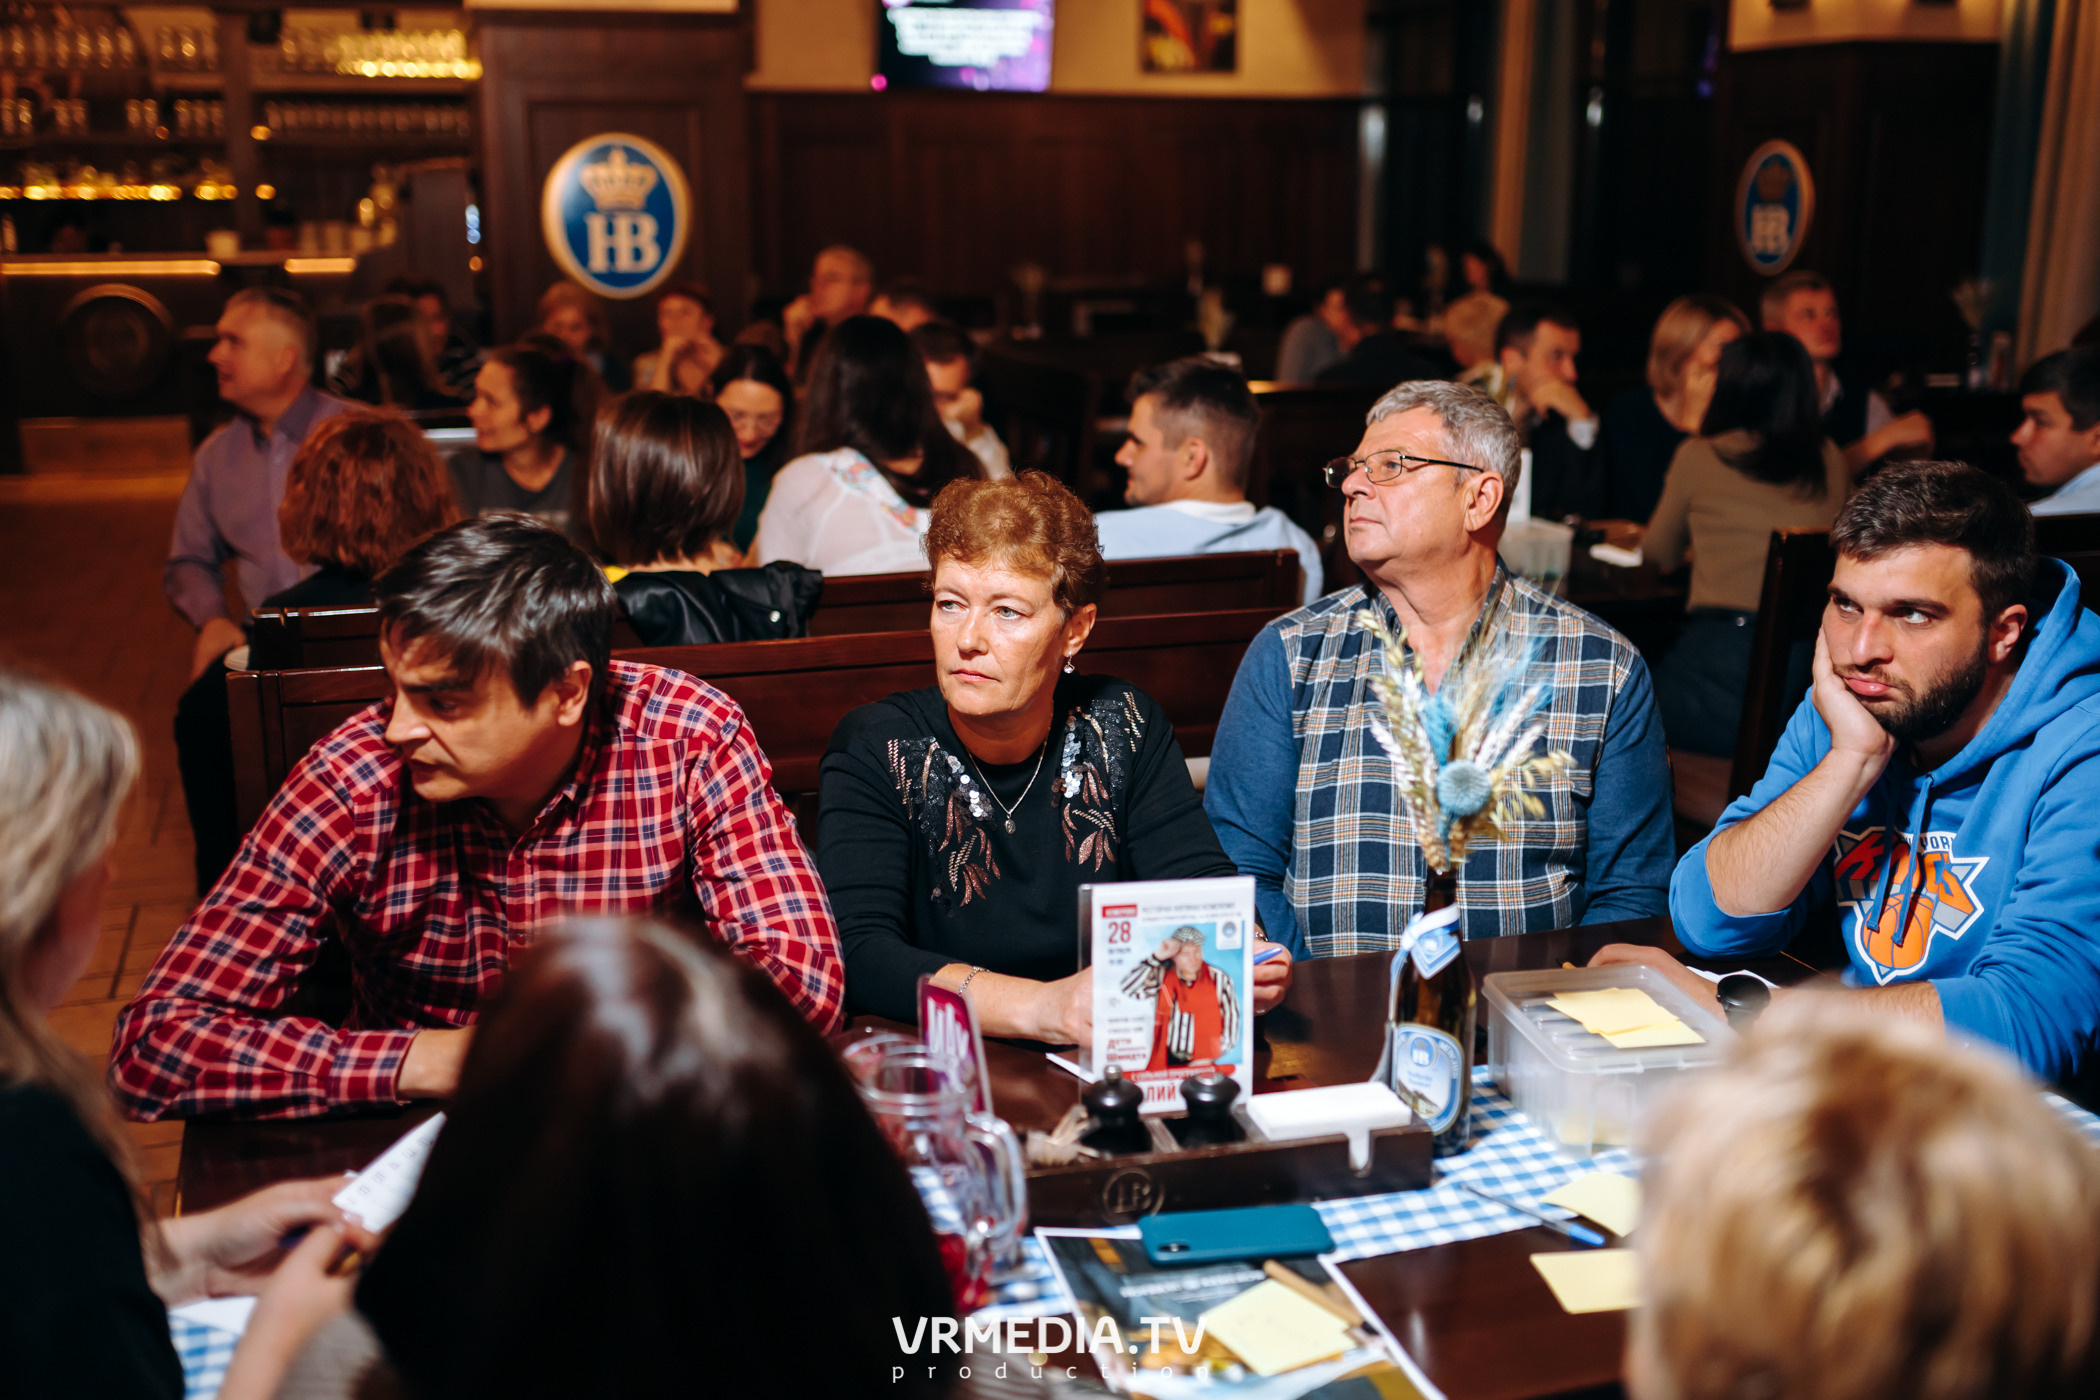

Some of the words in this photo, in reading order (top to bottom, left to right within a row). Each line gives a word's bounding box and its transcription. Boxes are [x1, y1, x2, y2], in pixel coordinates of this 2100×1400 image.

[584, 211, 661, 274] HB
[1920, 835, 1953, 850] YOR
[1108, 921, 1131, 944] 28
